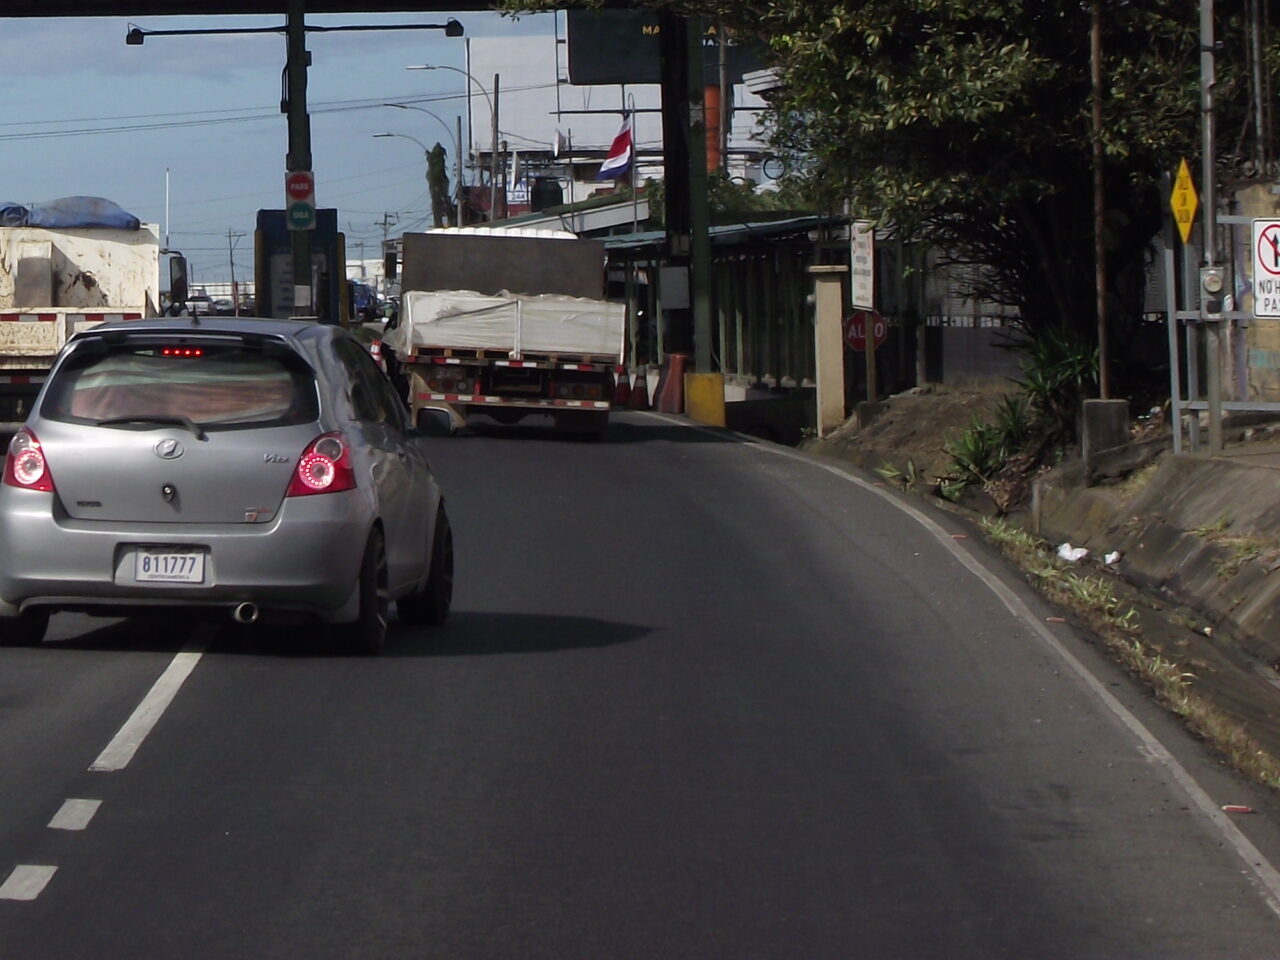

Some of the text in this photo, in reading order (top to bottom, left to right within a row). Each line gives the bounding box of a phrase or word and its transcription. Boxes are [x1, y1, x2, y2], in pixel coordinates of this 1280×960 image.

[1259, 280, 1272, 295] NO
[1264, 298, 1280, 312] PA
[848, 322, 884, 339] ALO
[143, 556, 197, 574] 811777
